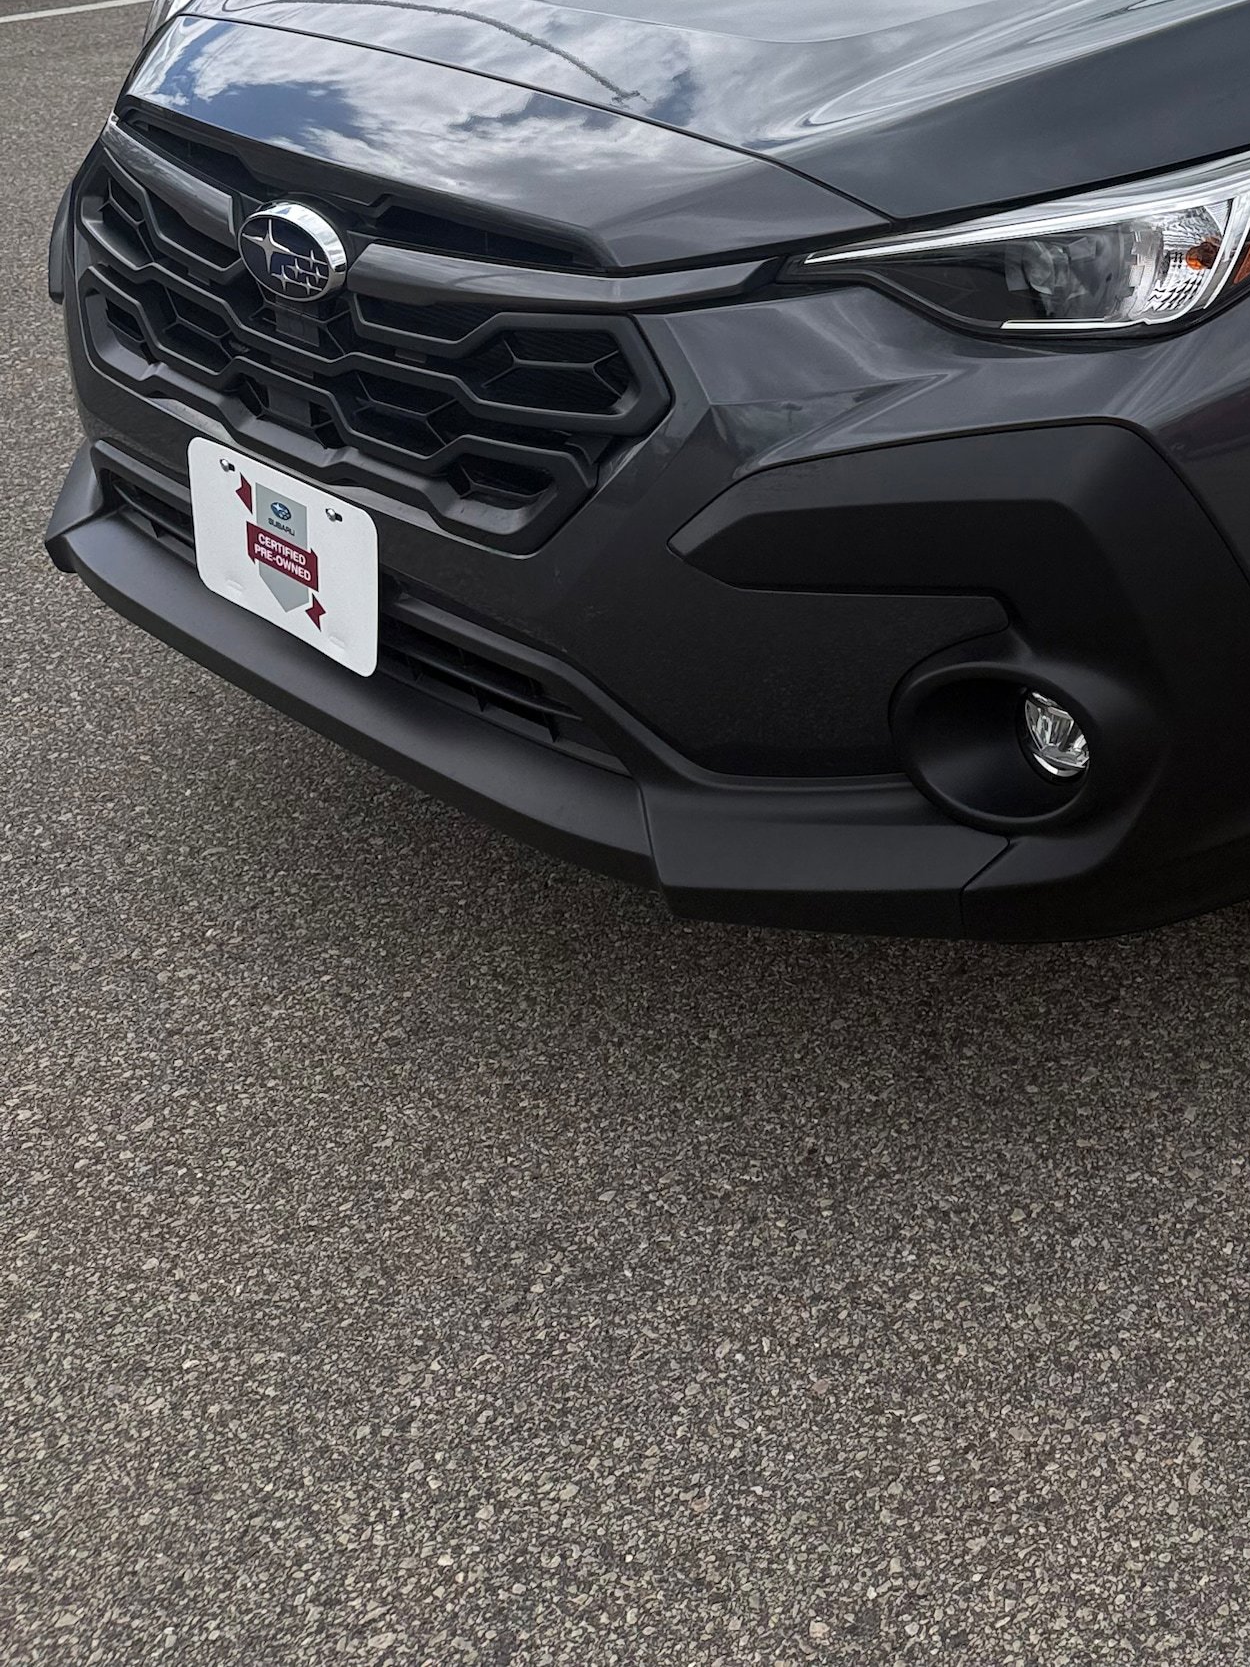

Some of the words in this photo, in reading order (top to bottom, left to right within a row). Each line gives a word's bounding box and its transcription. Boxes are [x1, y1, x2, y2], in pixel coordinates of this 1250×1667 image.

[268, 518, 295, 536] SUBARU
[254, 543, 312, 581] PRE-OWNED
[258, 532, 306, 566] CERTIFIED
